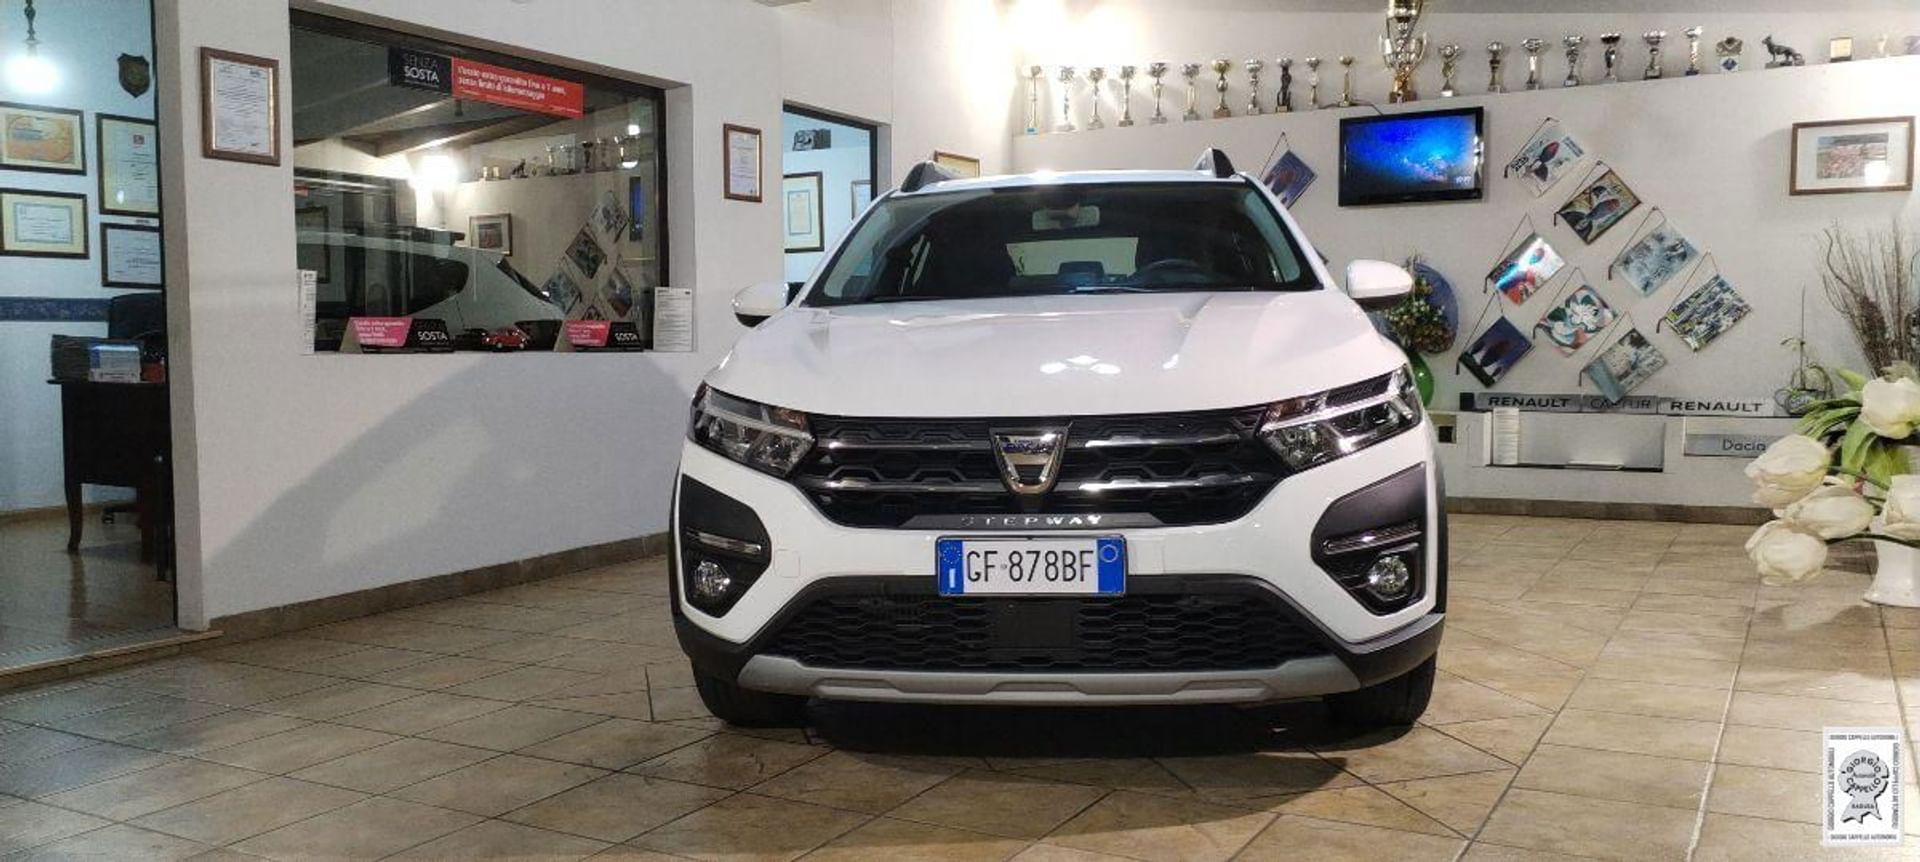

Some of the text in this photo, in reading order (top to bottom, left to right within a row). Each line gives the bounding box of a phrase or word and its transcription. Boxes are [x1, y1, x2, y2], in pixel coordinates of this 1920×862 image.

[404, 66, 440, 84] SOSTA
[417, 331, 448, 341] SOSTA
[1488, 396, 1571, 408] RENAULT
[1670, 401, 1763, 412] RENAULT
[1722, 439, 1767, 451] Dacia
[961, 514, 1102, 526] STEPWAY
[1008, 550, 1094, 582] 878BF
